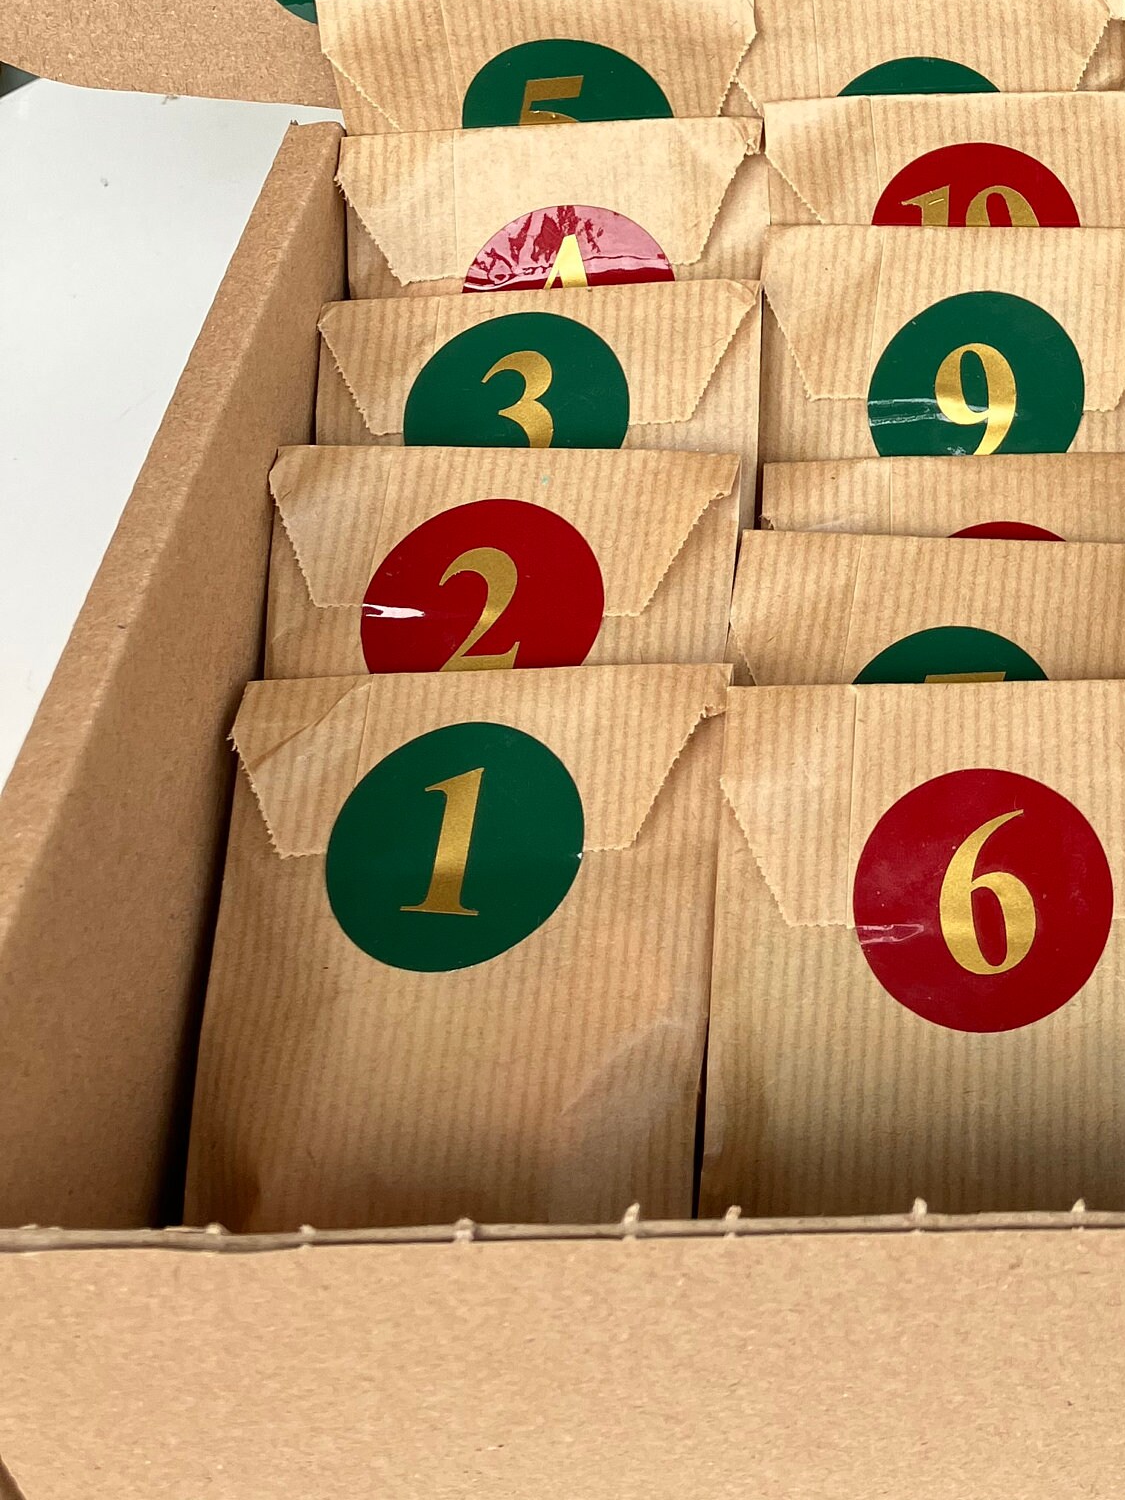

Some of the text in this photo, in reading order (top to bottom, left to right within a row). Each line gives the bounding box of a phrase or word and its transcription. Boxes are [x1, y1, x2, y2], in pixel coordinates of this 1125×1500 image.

[481, 349, 553, 450] 3
[934, 342, 1017, 456] 9
[438, 546, 523, 672] 2
[399, 766, 486, 917] 1
[939, 808, 1038, 976] 6
